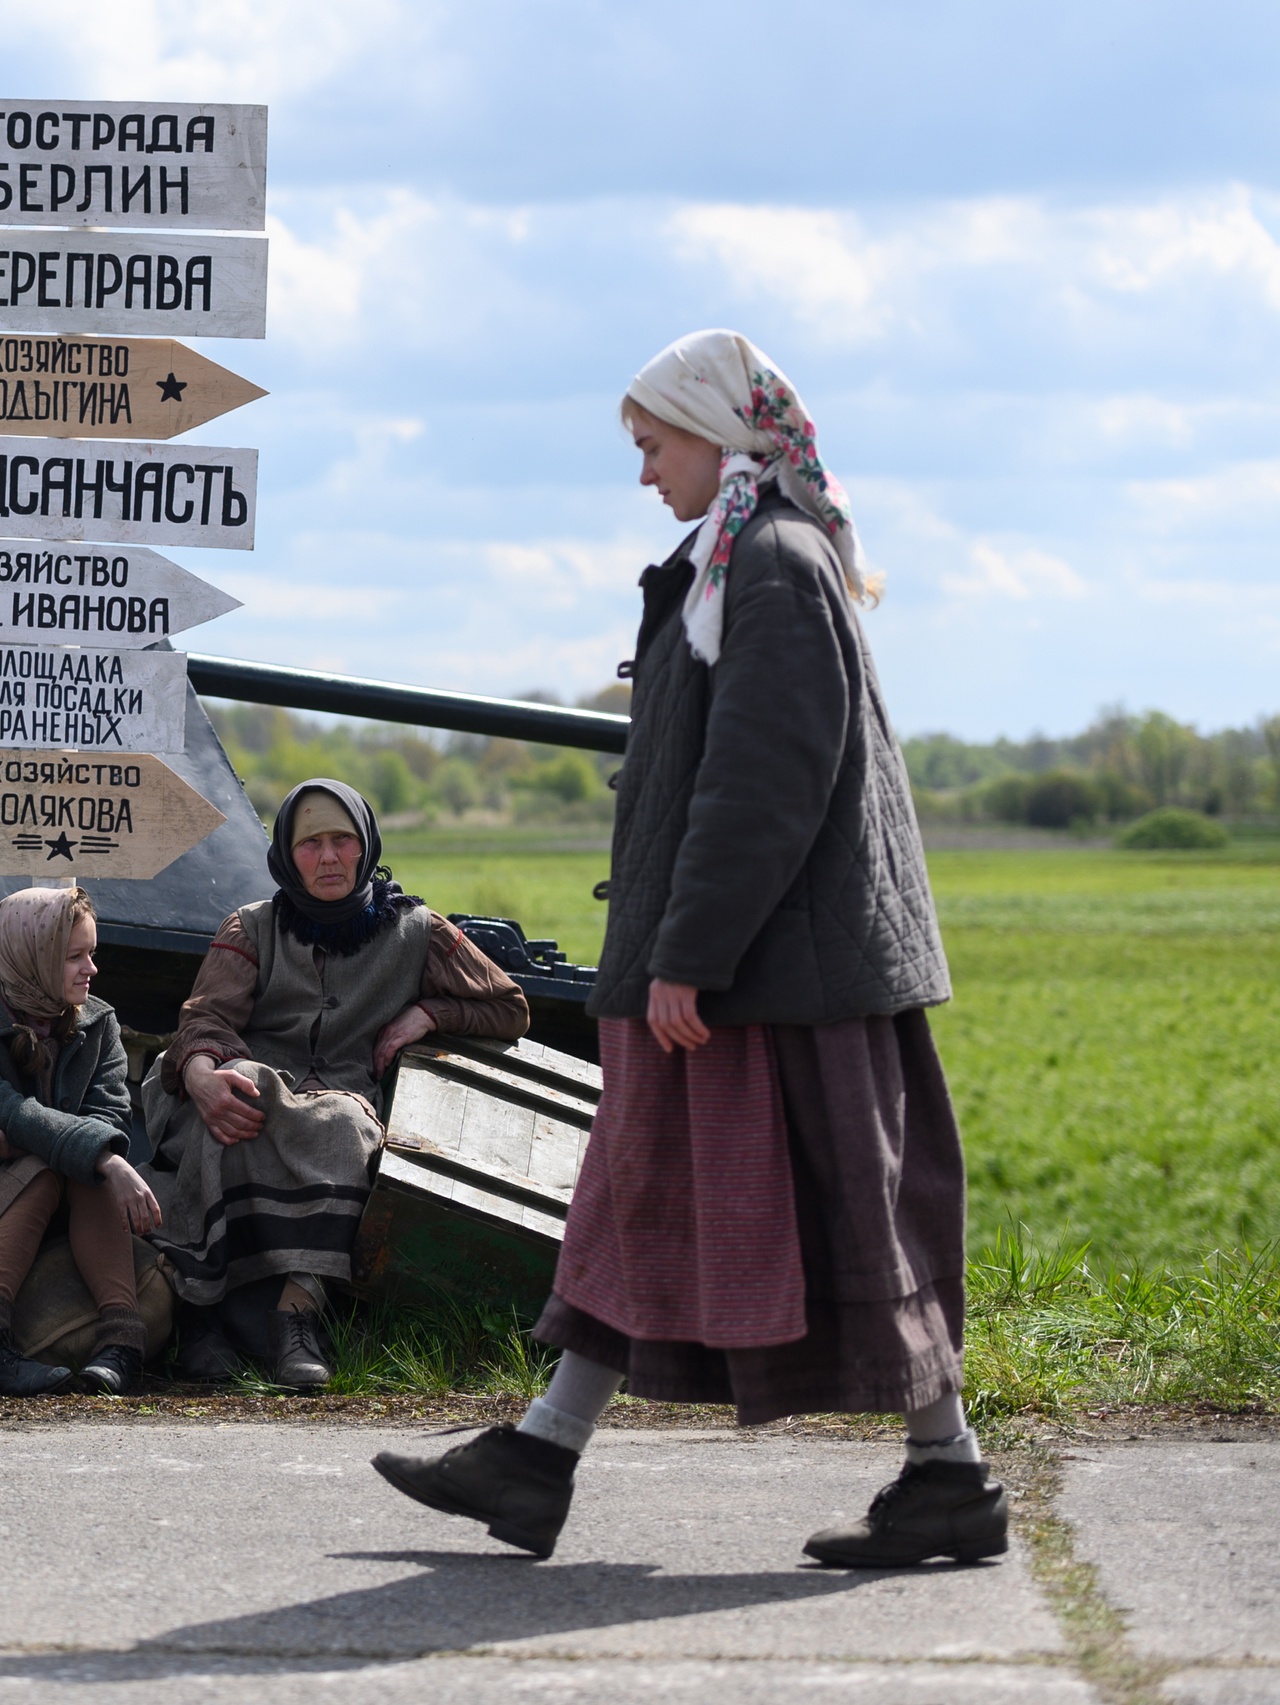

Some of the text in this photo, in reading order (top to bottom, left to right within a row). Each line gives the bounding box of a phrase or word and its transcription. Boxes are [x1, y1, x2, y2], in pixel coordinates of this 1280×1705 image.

[12, 593, 170, 635] ИВАНОВА
[35, 682, 143, 718] ПОСАДКИ
[0, 710, 123, 746] РАНЕНЫХ
